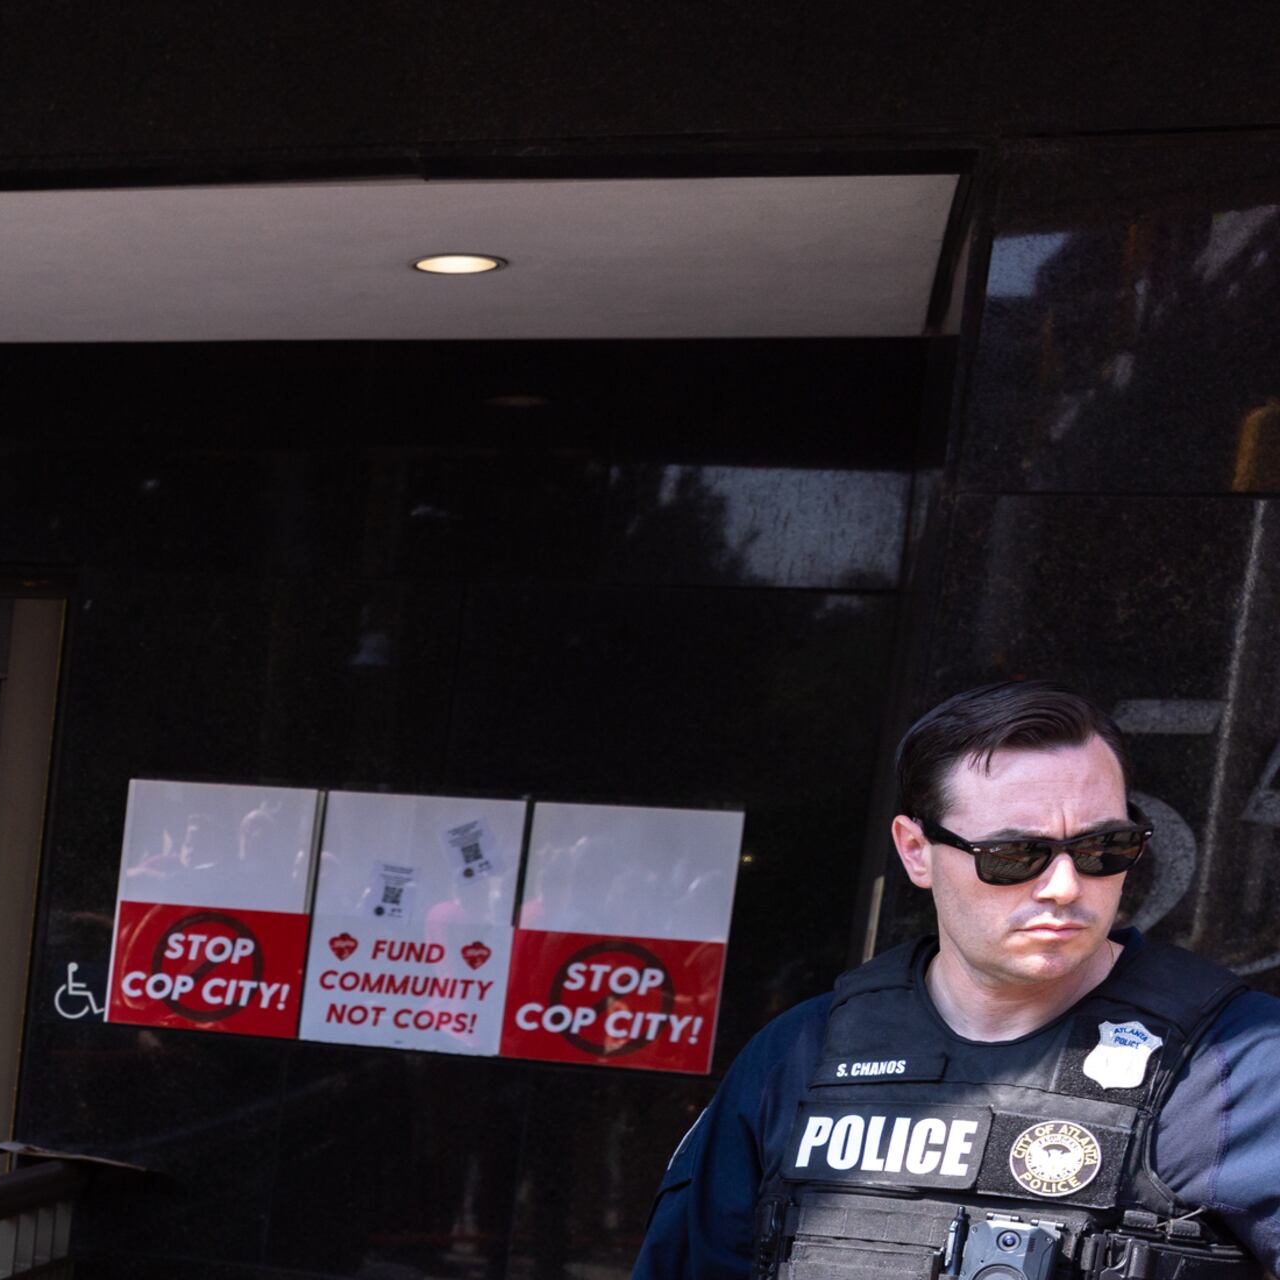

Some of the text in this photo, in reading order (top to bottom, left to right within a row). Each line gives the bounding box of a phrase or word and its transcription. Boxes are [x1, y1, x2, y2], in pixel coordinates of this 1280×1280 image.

[164, 932, 256, 965] STOP
[371, 939, 446, 965] FUND
[121, 970, 291, 1011] COP CITY!
[319, 969, 495, 1002] COMMUNITY
[562, 961, 666, 996] STOP
[326, 1003, 478, 1035] NOT COPS!
[514, 1002, 704, 1045] COP CITY!
[1114, 1027, 1148, 1042] ATLANTA
[837, 1063, 849, 1078] S.
[795, 1114, 980, 1177] POLICE
[1013, 1123, 1098, 1166] CITY OF ATLANTA
[1018, 1171, 1081, 1193] POLICE
